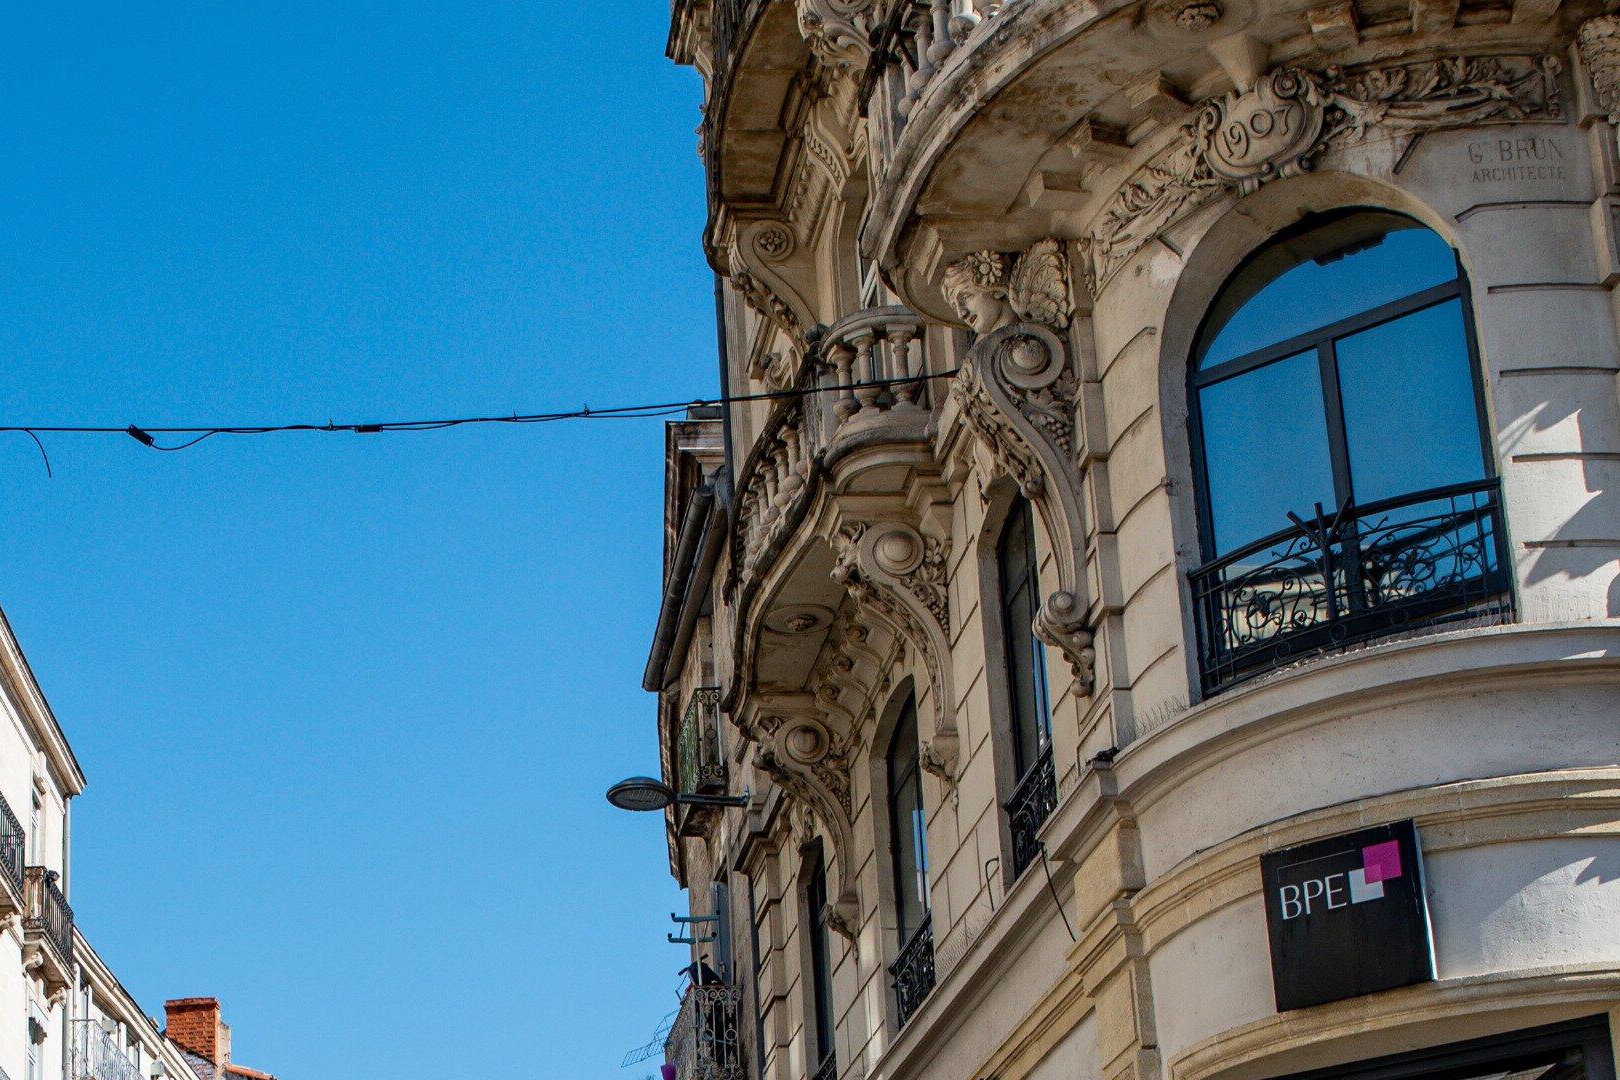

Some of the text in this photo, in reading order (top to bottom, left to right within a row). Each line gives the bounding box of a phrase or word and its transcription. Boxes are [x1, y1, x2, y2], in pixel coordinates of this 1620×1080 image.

[1222, 104, 1295, 159] 1907
[1498, 138, 1563, 161] BRUN
[1280, 872, 1347, 920] BPE
